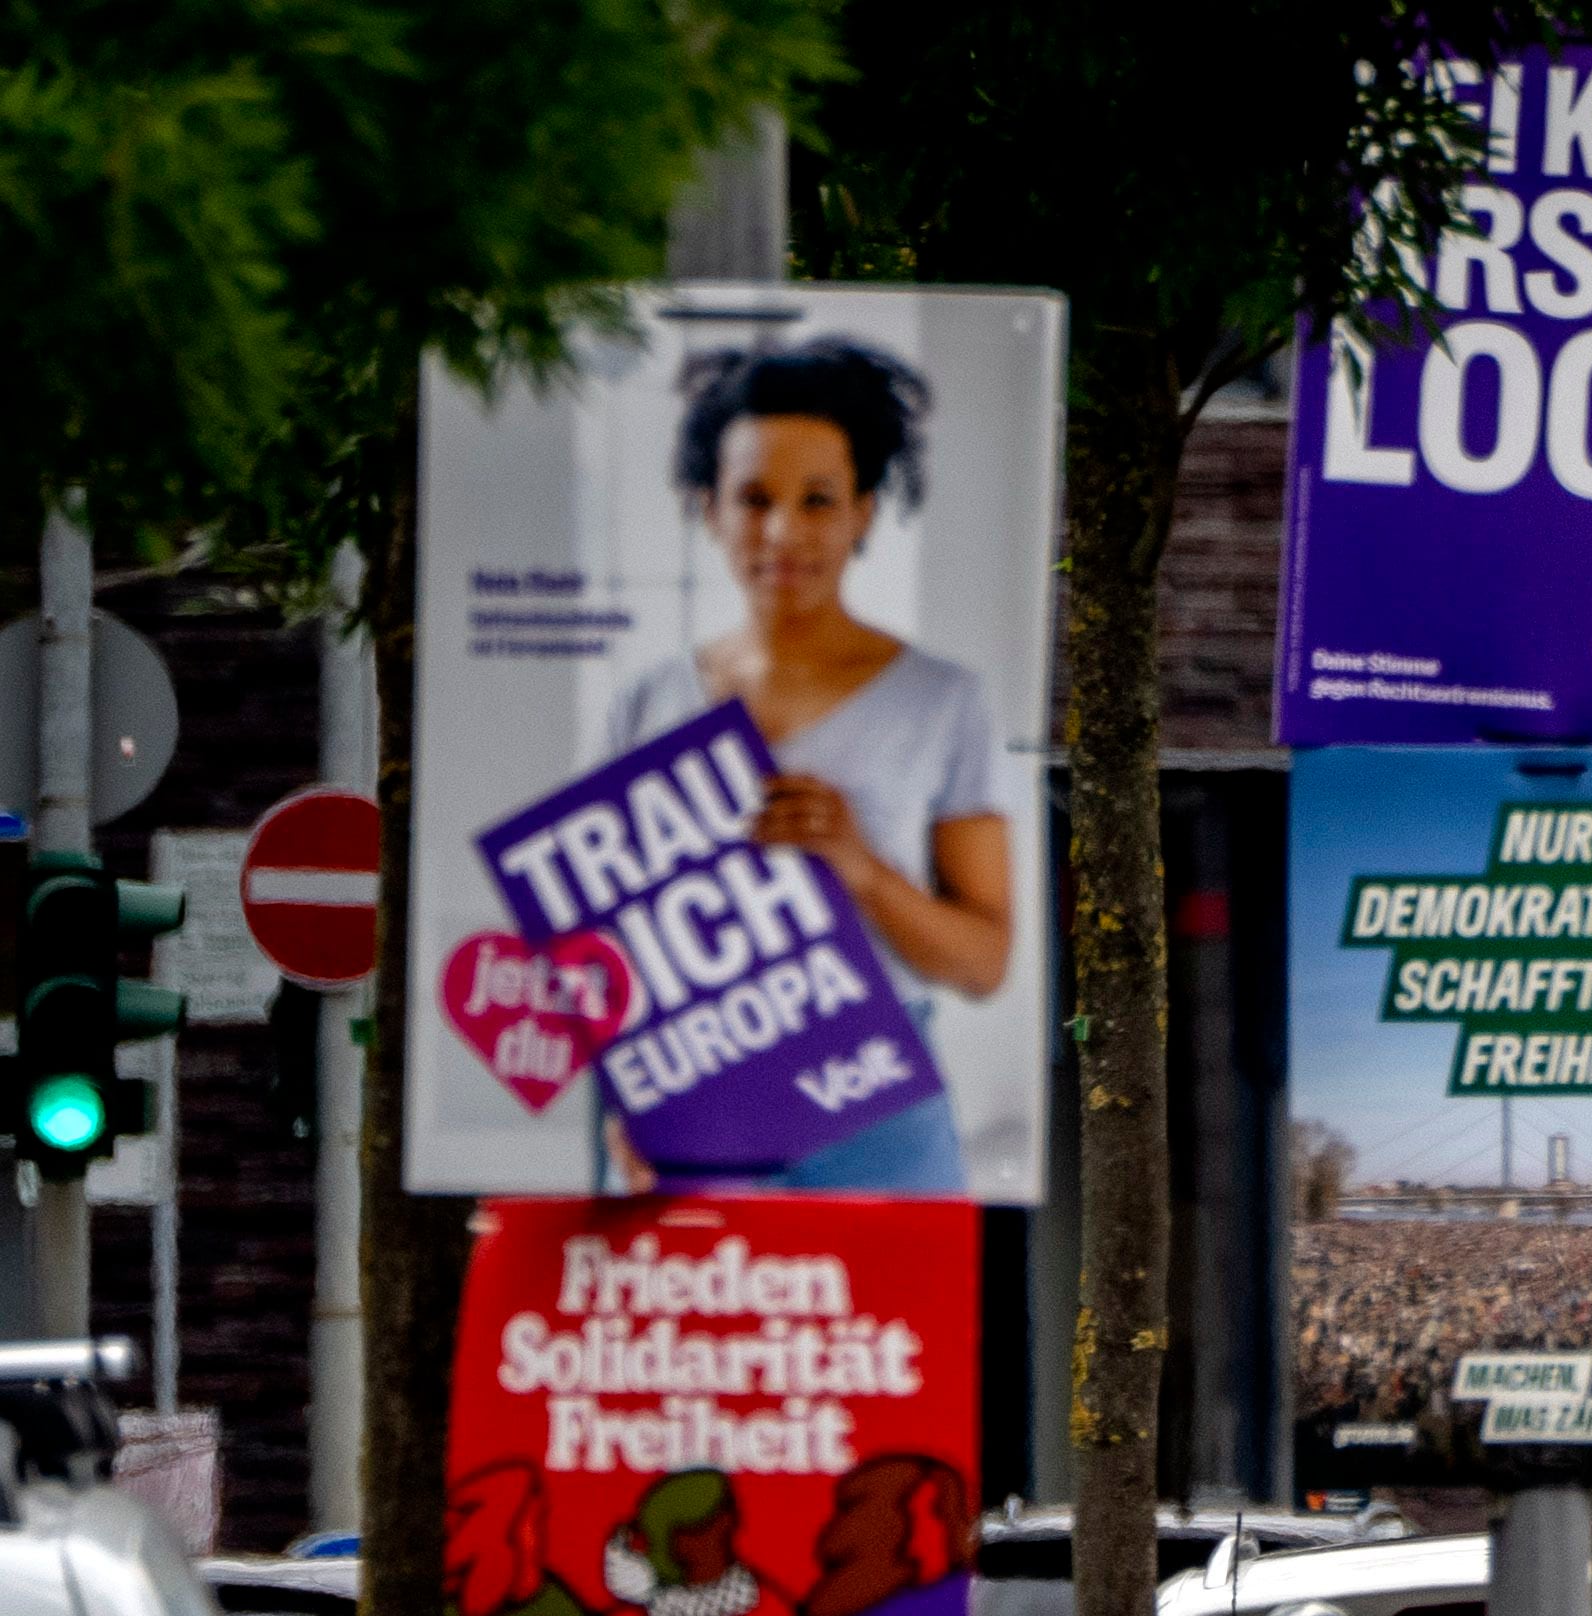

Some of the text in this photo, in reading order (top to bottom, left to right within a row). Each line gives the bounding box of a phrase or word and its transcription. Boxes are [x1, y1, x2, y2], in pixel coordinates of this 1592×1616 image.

[499, 728, 761, 931] TRAU
[464, 941, 611, 1021] jetzt
[496, 1018, 572, 1083] du
[602, 944, 868, 1114] EUROPA
[796, 1039, 914, 1114] Volt
[557, 1234, 852, 1317] Frieden
[499, 1311, 923, 1396] Solidarität
[546, 1393, 858, 1475] Freiheit
[1494, 1405, 1547, 1432] WAS
